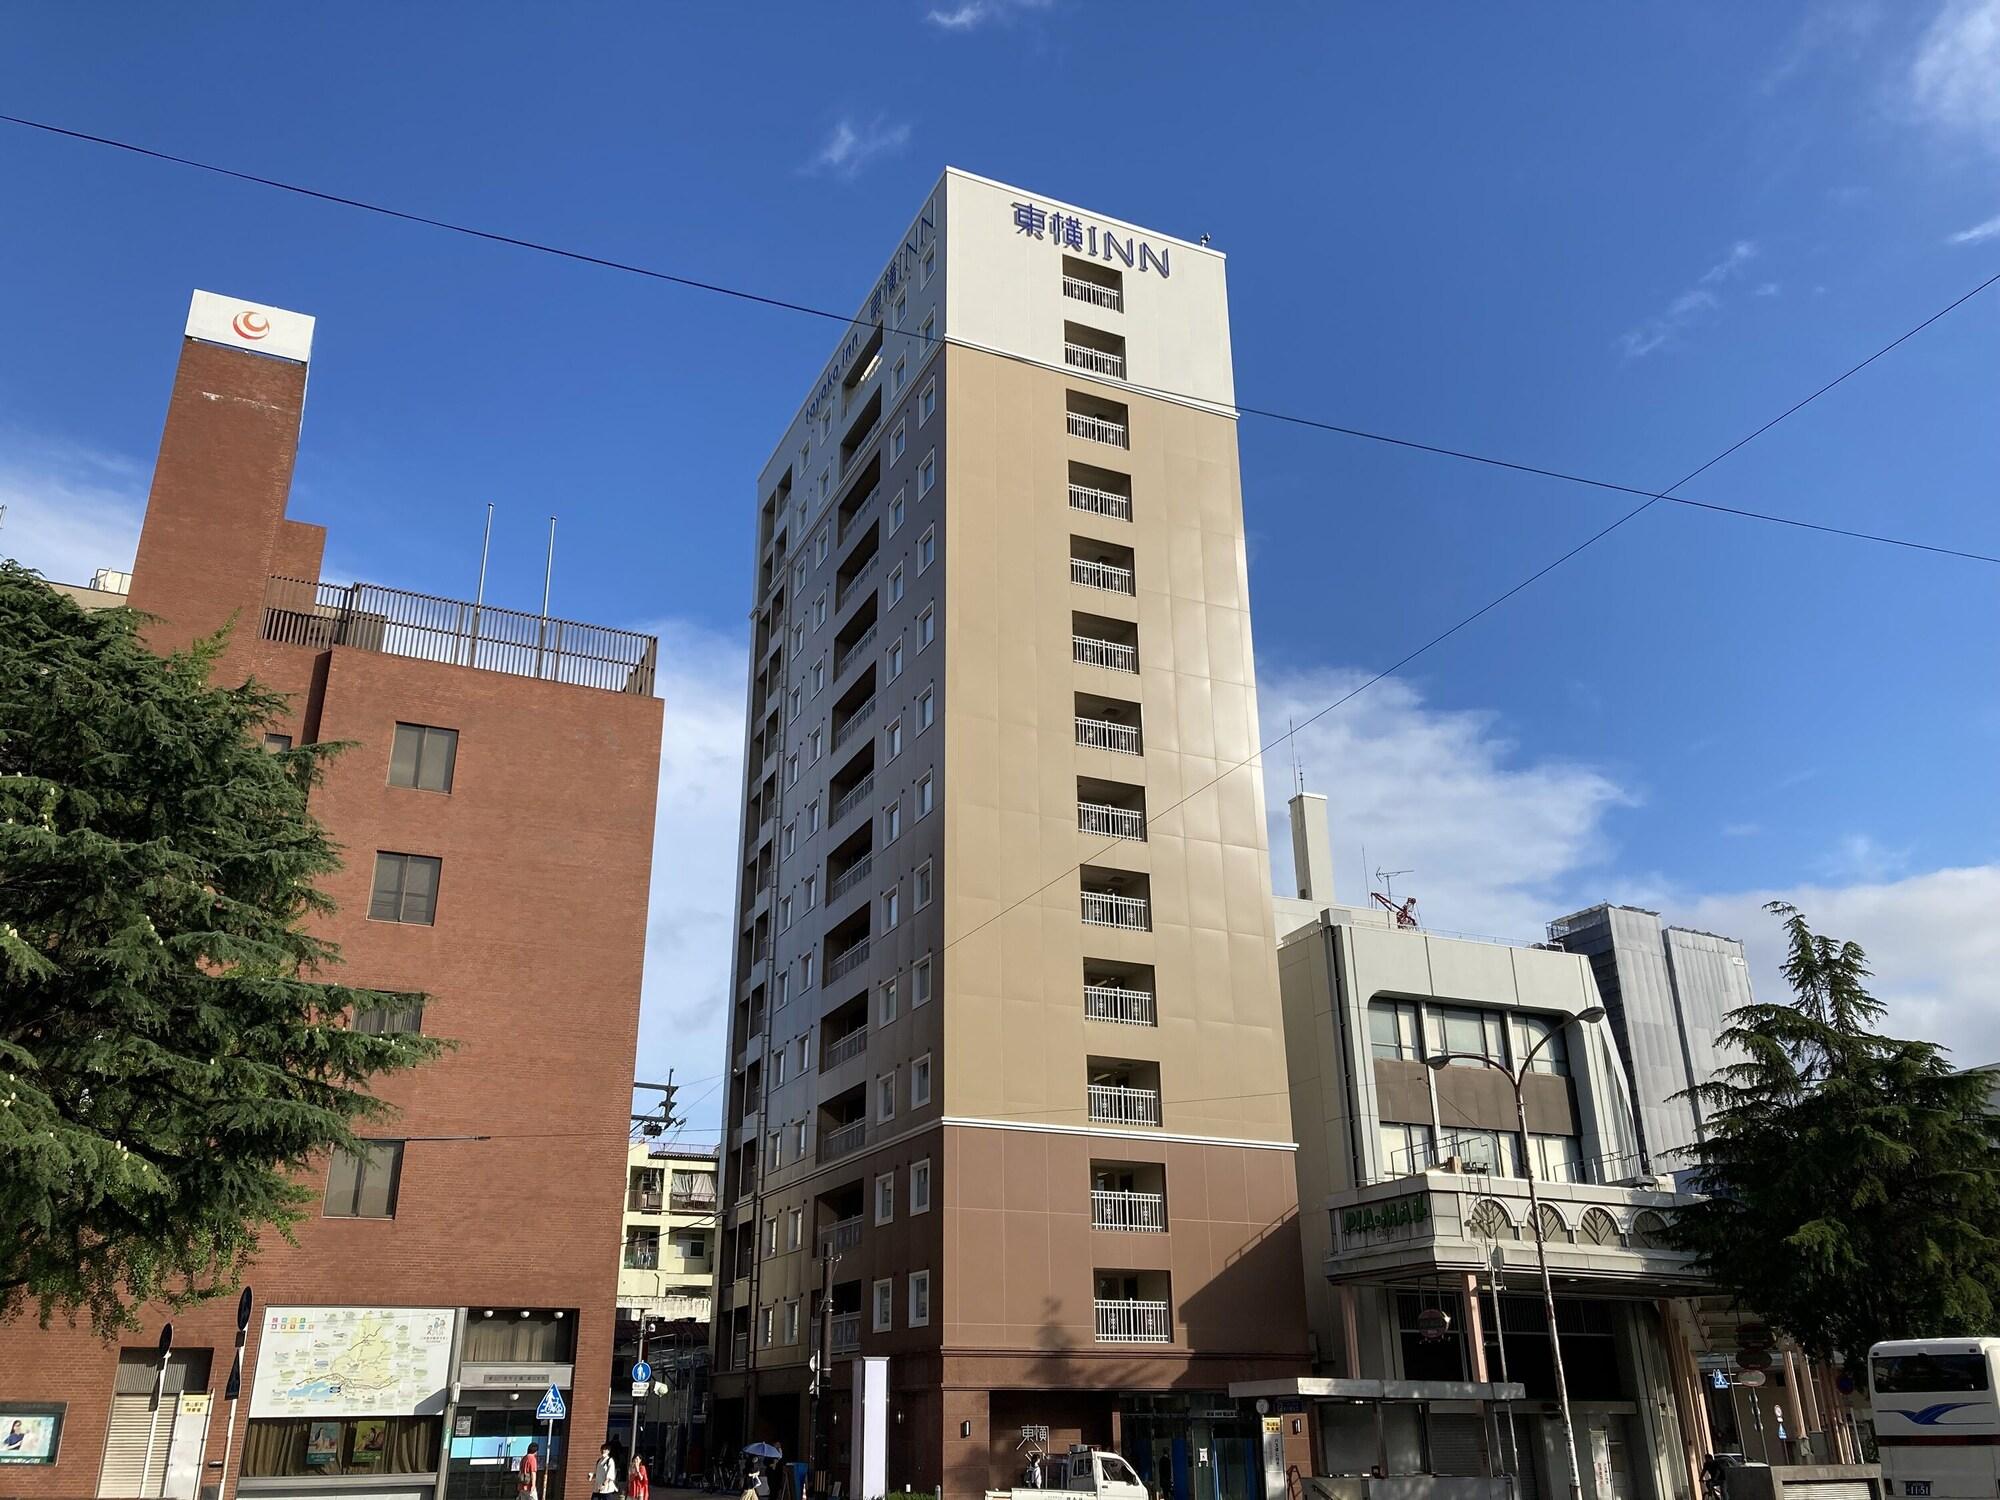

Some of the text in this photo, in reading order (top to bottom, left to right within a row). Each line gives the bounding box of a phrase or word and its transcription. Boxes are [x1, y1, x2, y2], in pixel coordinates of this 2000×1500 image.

[1010, 202, 1171, 280] 東横INN
[805, 332, 860, 424] toyoko inn
